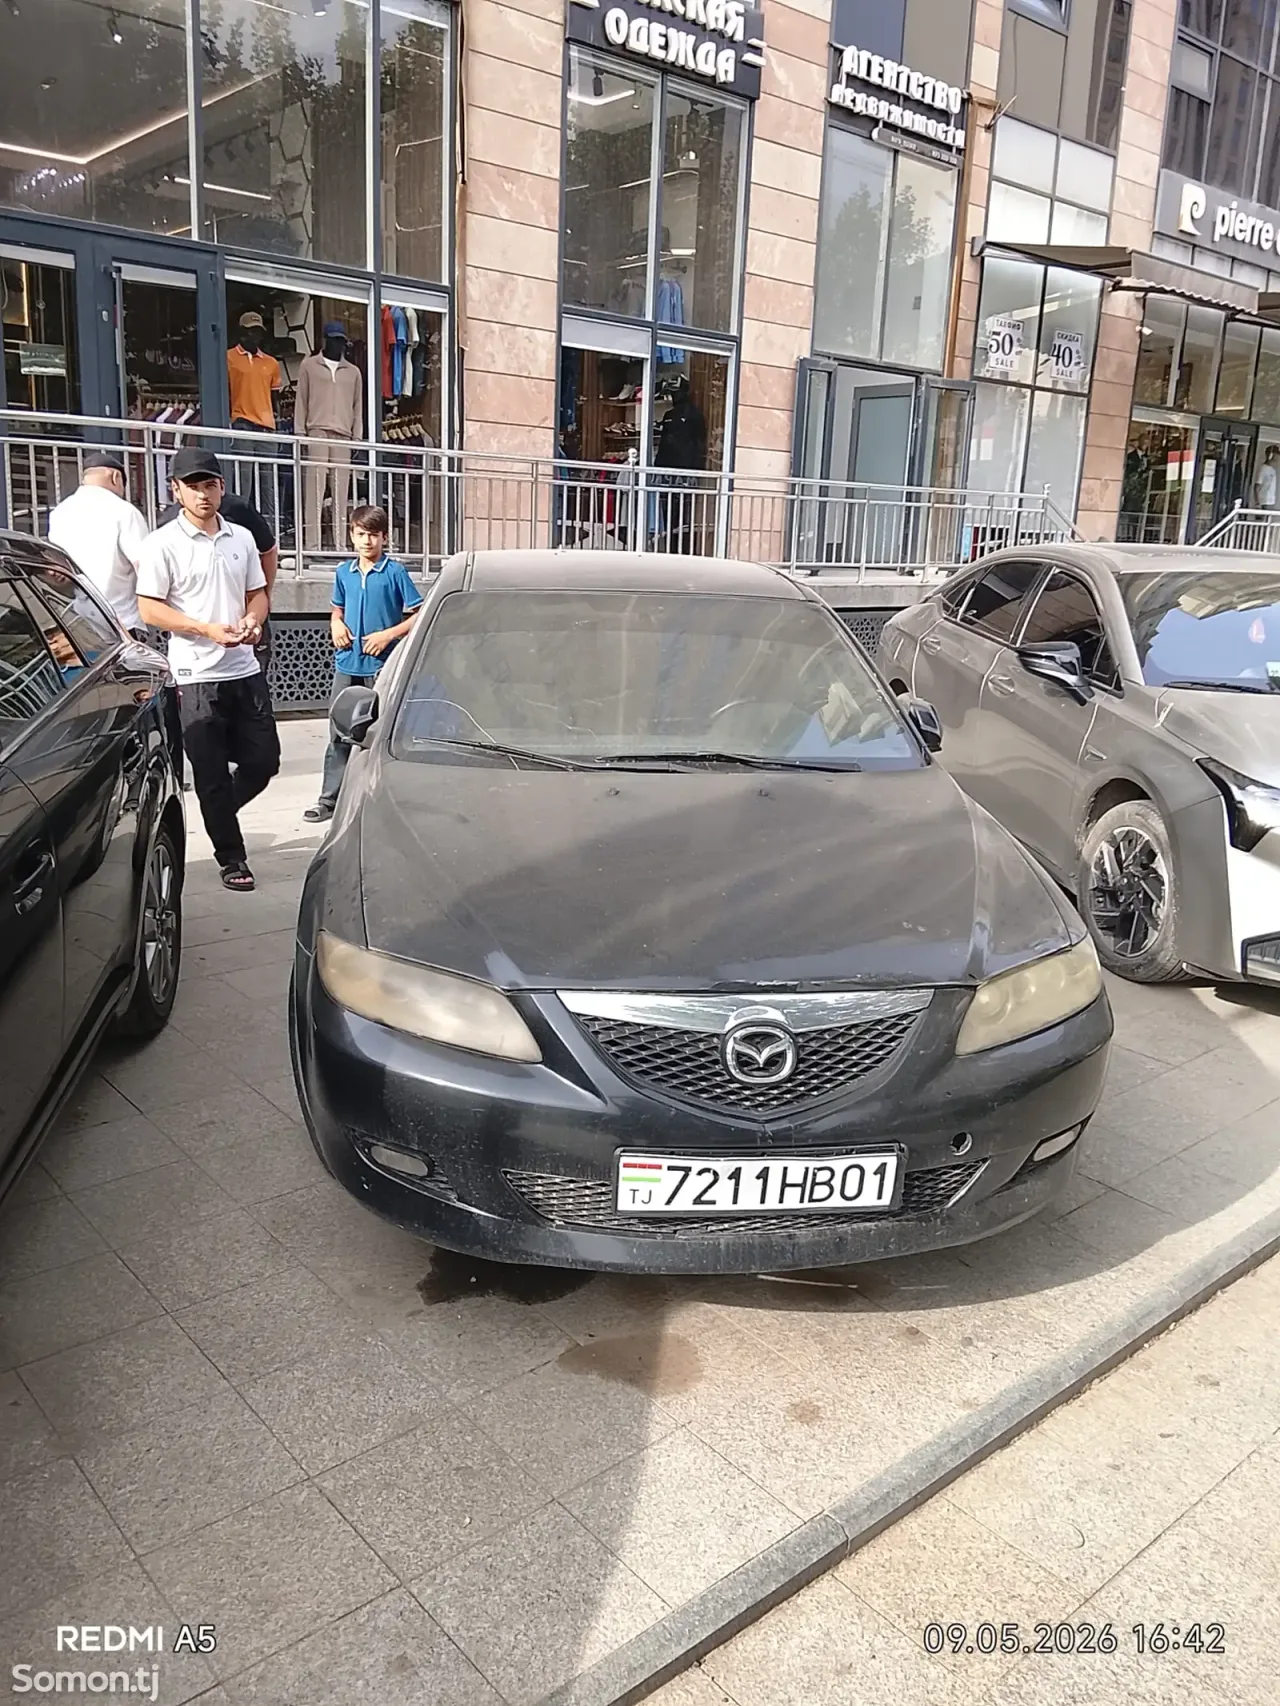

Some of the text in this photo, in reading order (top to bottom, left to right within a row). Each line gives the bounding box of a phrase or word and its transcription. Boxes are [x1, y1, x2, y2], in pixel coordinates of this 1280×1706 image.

[604, 7, 736, 85] ОДЕЖДА
[842, 45, 962, 114] АГЕНТСТВО
[1213, 200, 1274, 250] pierre
[988, 331, 1013, 356] 50
[1056, 331, 1080, 343] СКИДКА
[995, 358, 1014, 369] SALE
[1051, 343, 1073, 368] 40
[1055, 368, 1073, 378] SALE
[664, 1161, 889, 1207] 7211HB01
[628, 1188, 653, 1206] TJ
